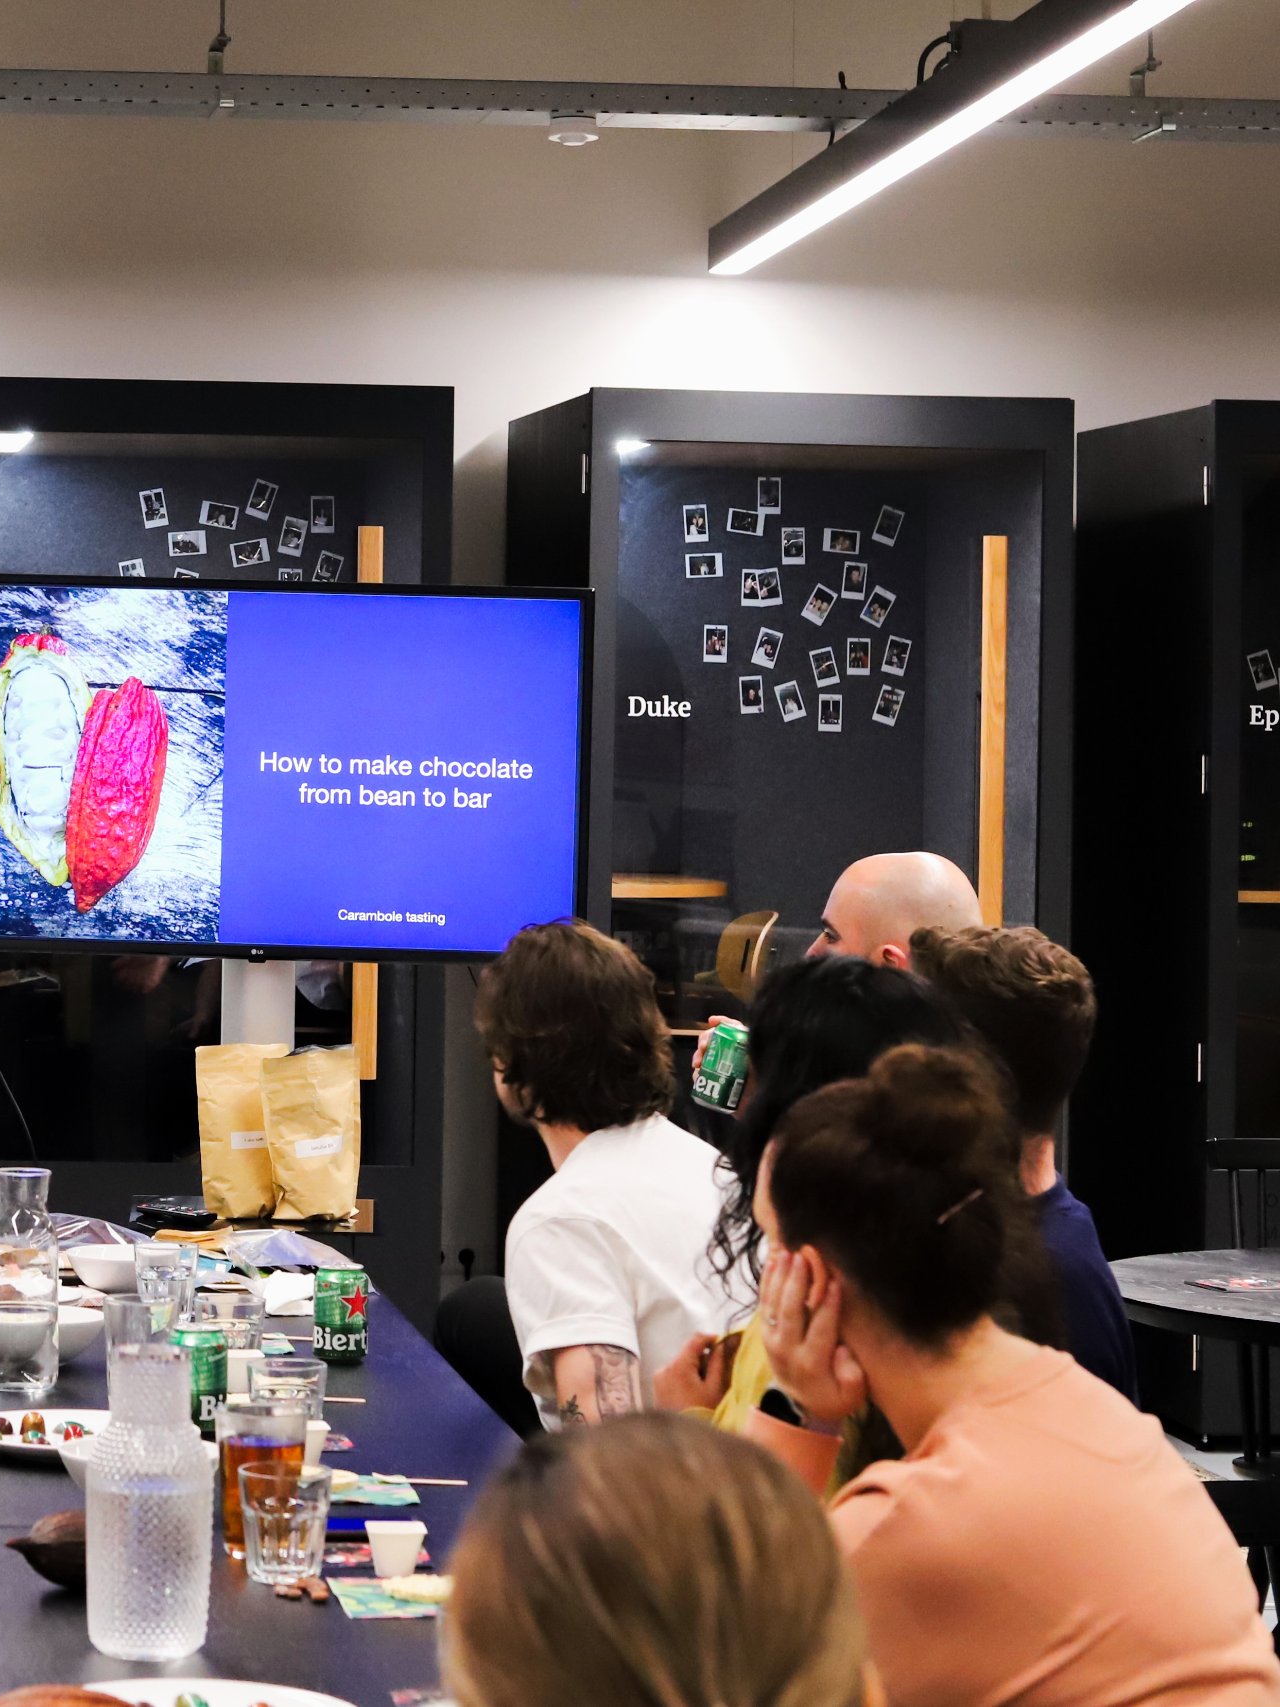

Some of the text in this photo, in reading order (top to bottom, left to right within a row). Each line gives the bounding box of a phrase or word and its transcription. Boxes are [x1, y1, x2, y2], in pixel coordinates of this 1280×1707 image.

[627, 694, 692, 718] Duke
[1249, 704, 1280, 731] Ep
[259, 751, 533, 779] How to make chocolate
[299, 783, 492, 809] from bean to bar
[337, 908, 445, 926] Carambole tasting
[693, 1075, 721, 1099] en
[313, 1326, 369, 1354] Biert
